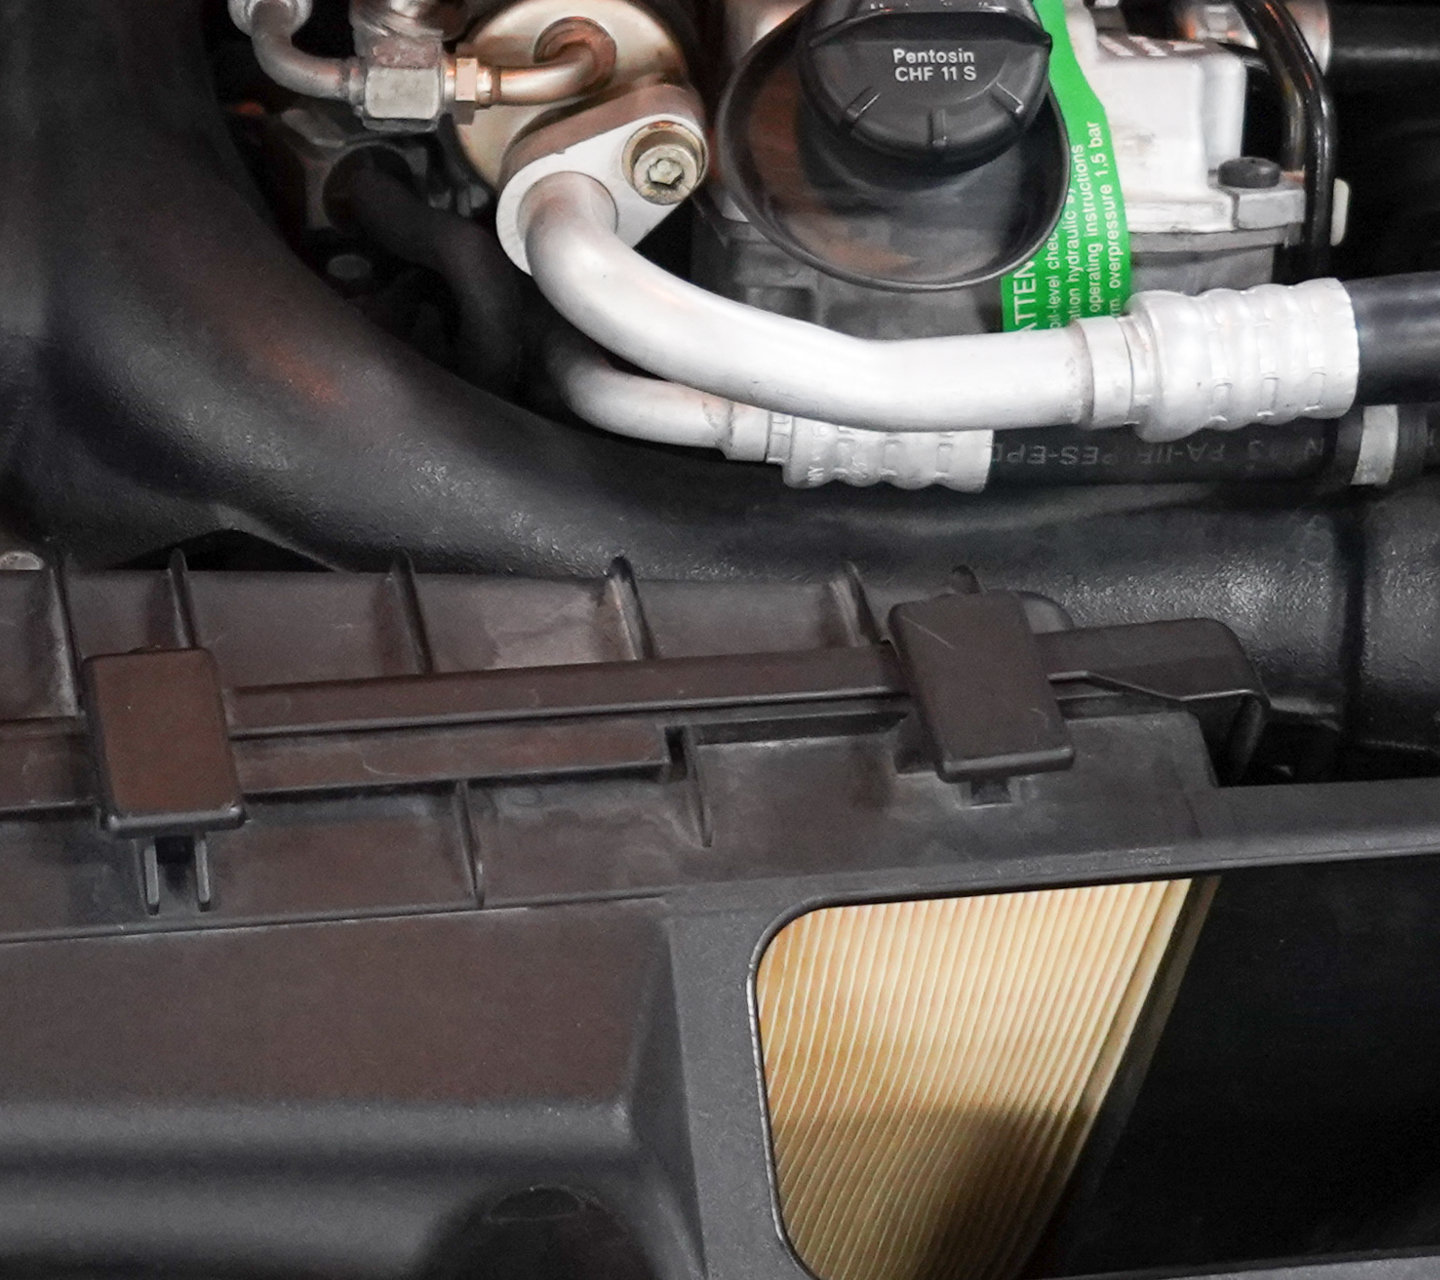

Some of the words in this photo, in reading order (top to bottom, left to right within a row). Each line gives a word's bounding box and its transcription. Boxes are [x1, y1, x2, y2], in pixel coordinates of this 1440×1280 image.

[892, 48, 975, 64] Pentosin
[894, 67, 934, 82] CHF
[941, 66, 957, 81] 11
[963, 66, 977, 81] S
[1087, 121, 1103, 148] bar
[1071, 144, 1098, 237] instructions
[1061, 210, 1084, 282] hydraulic
[1099, 184, 1124, 289] overpressure
[1084, 243, 1103, 312] operating
